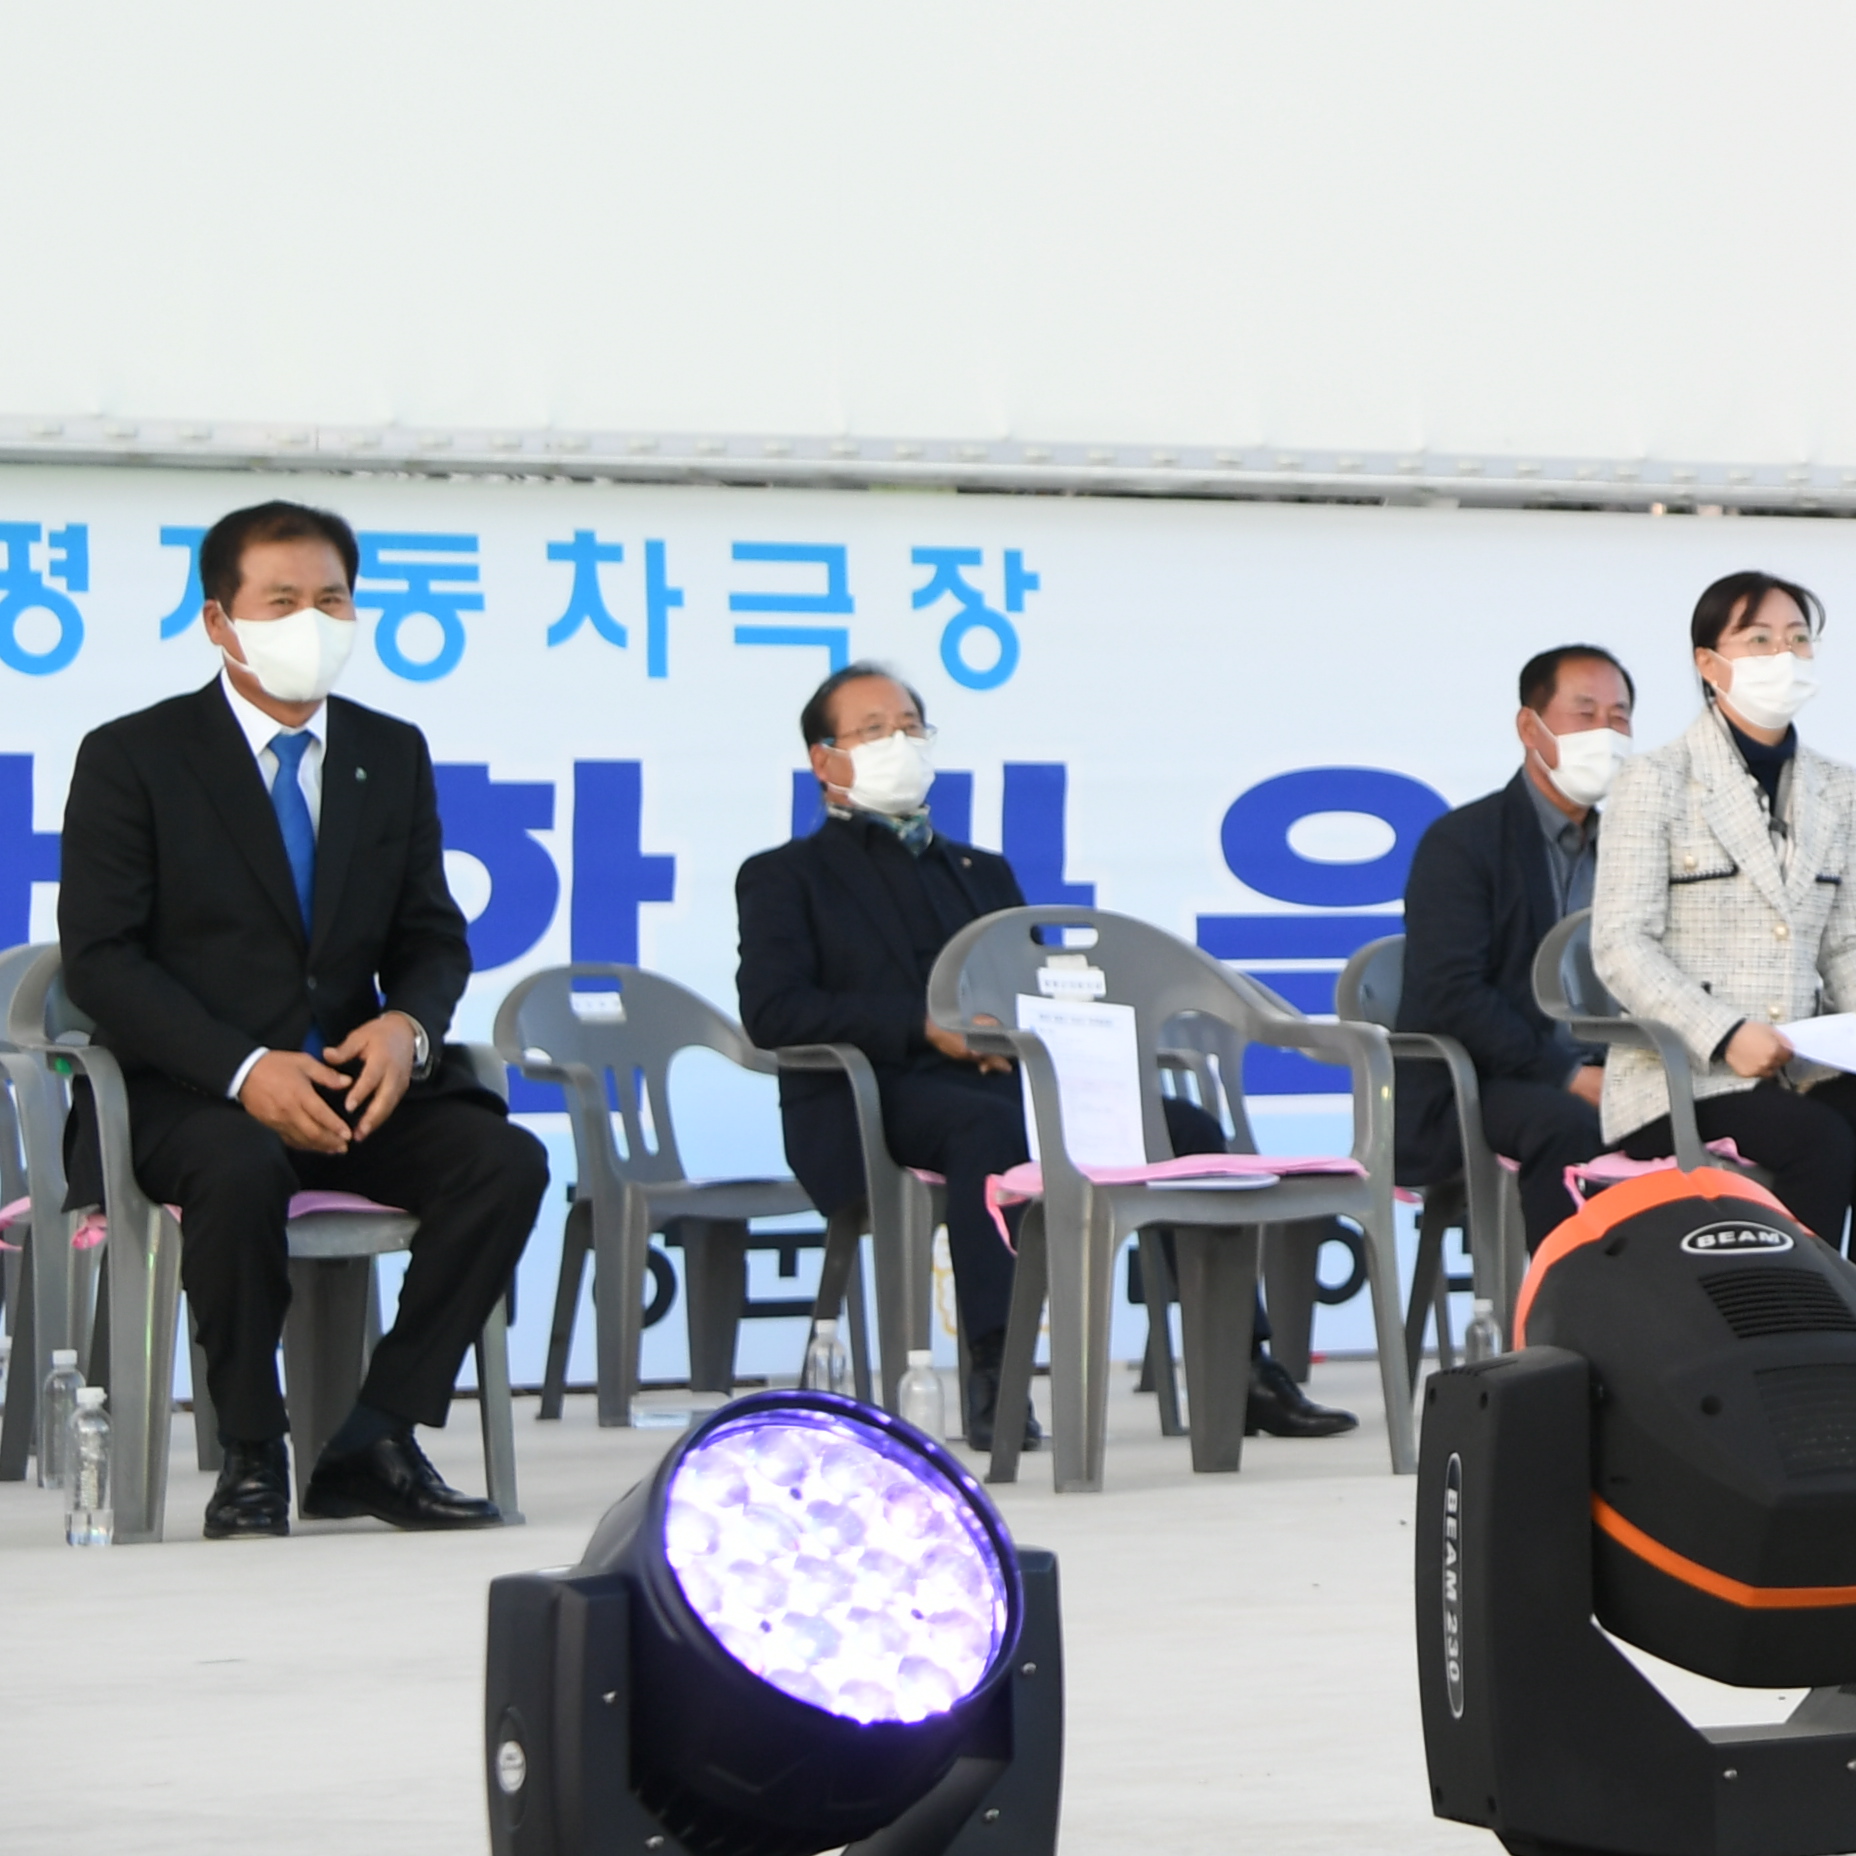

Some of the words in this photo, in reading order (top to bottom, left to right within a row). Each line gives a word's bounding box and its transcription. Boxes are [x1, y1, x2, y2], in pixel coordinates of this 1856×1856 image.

[1696, 1227, 1782, 1249] BEAM
[1443, 1485, 1461, 1603] BEAM
[1445, 1614, 1461, 1685] 230
